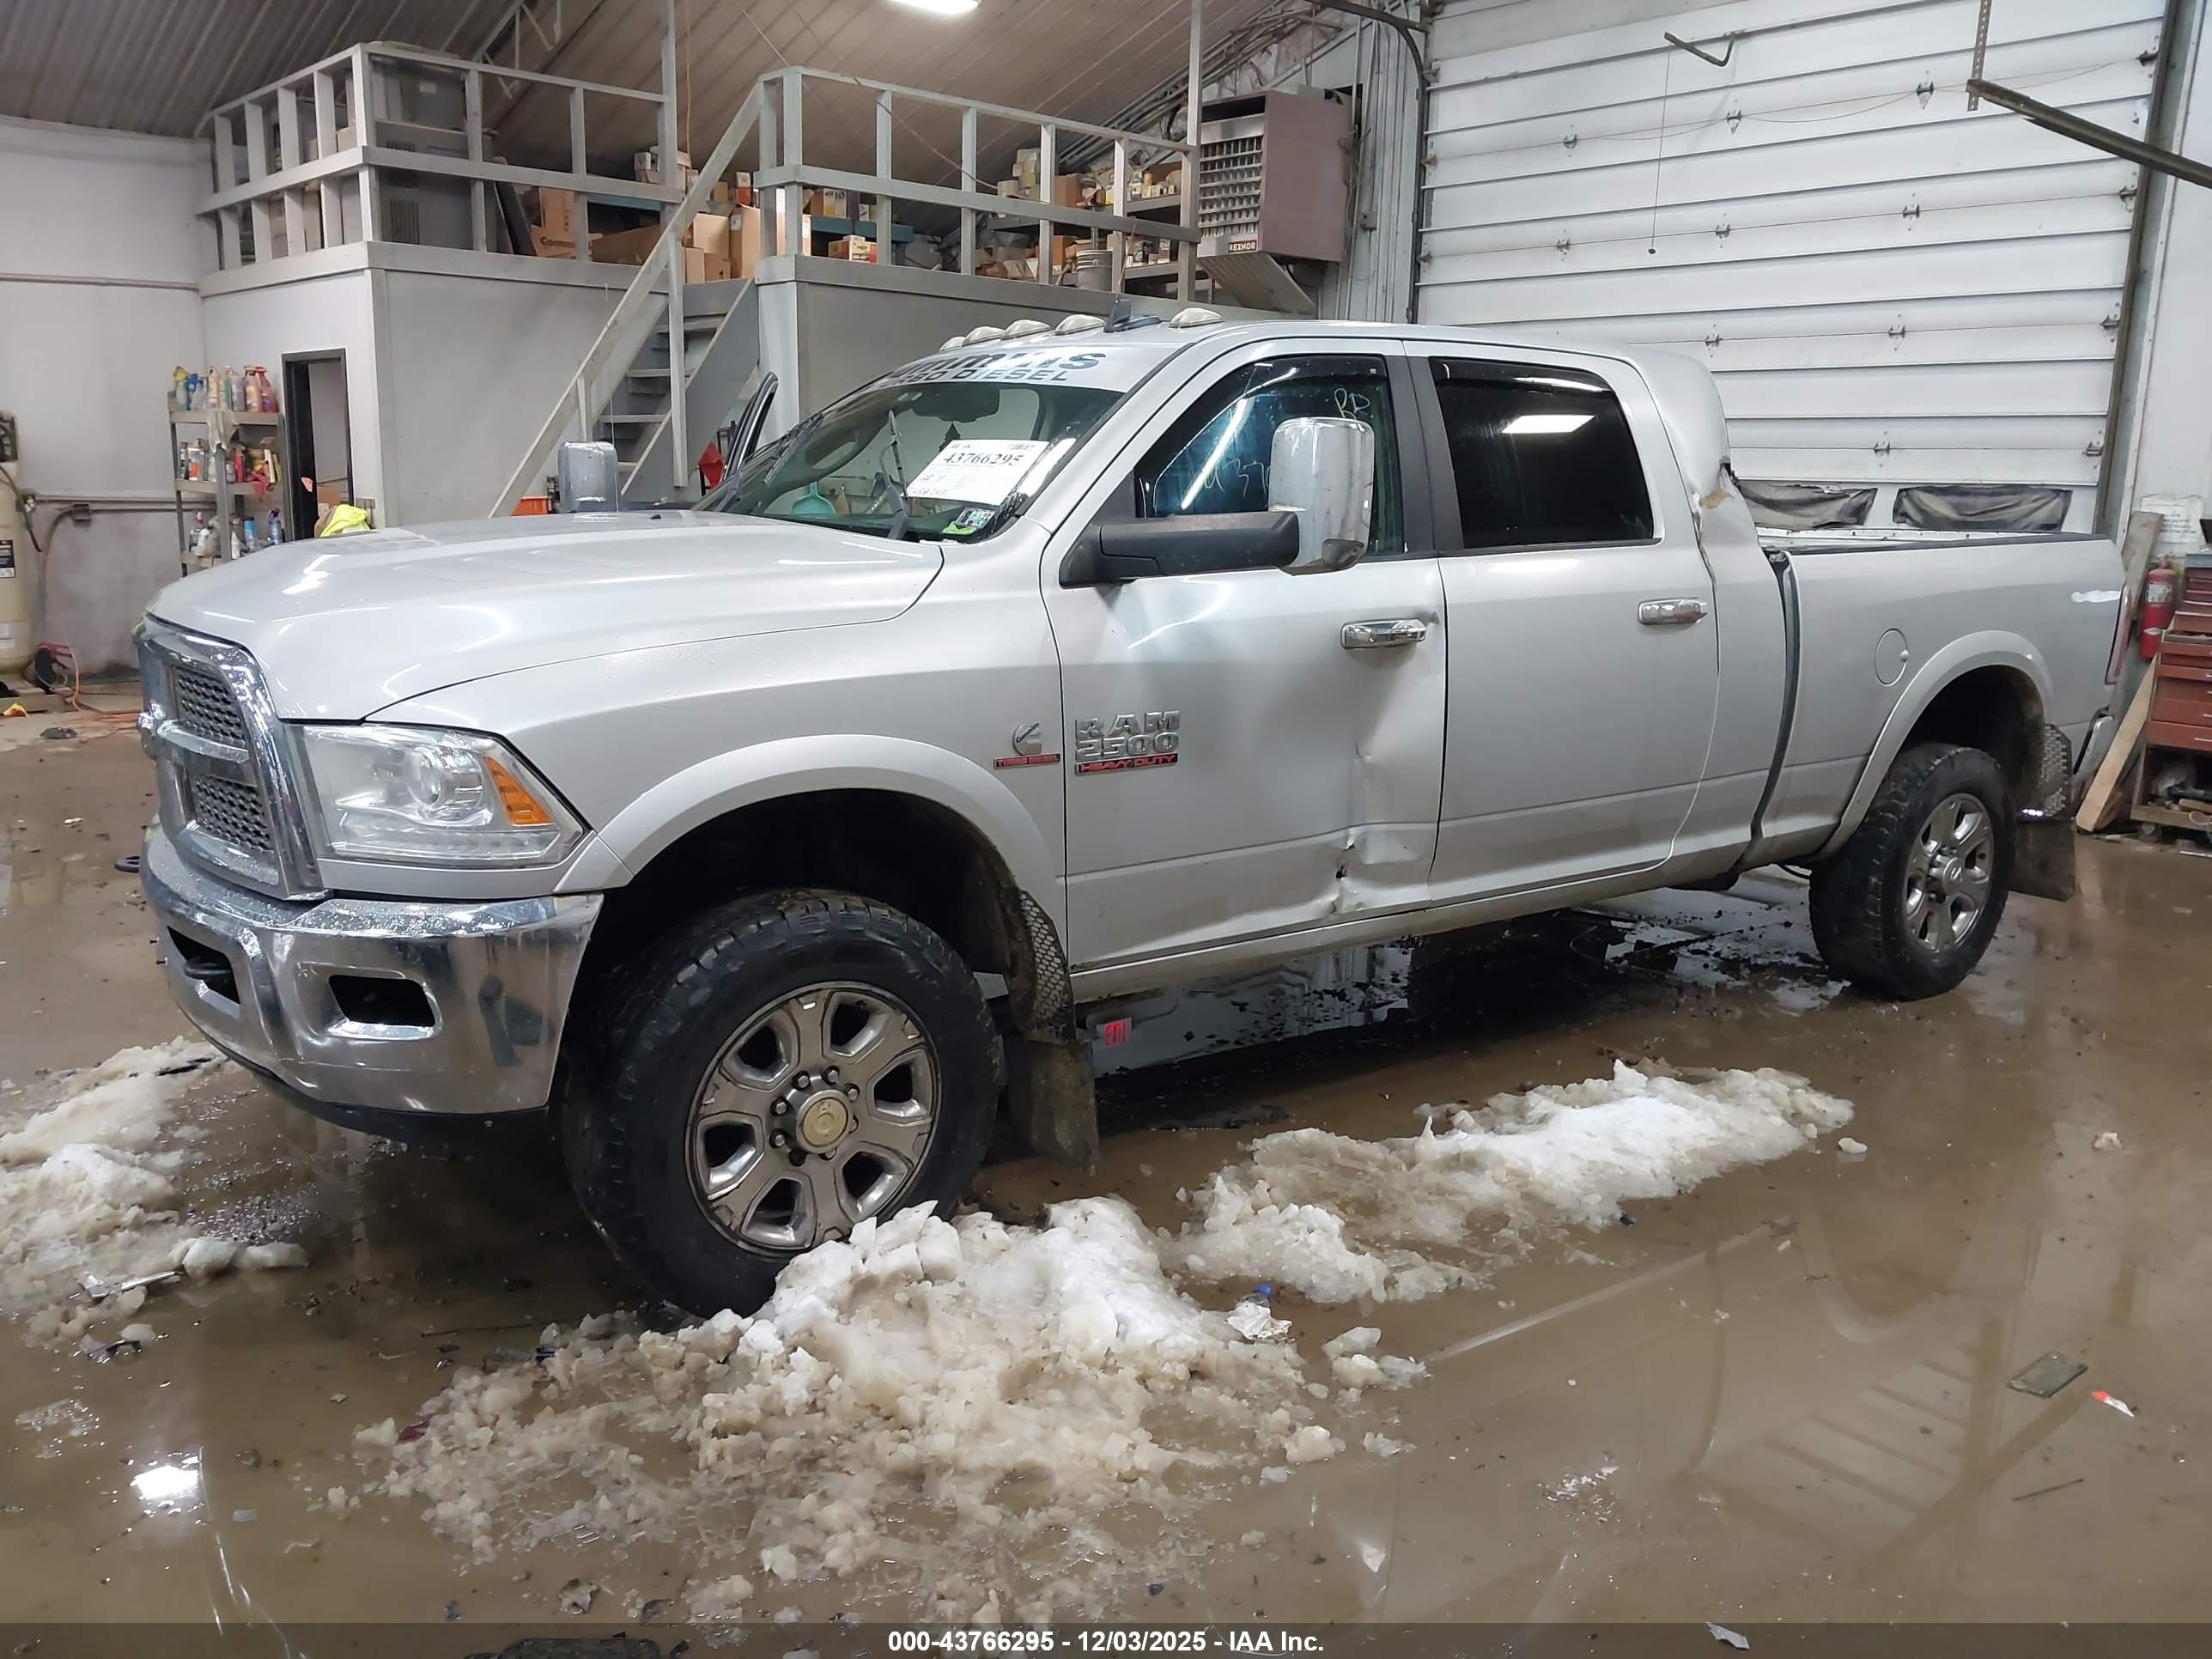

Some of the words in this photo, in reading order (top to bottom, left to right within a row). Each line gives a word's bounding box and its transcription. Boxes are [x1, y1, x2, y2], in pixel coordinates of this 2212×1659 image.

[1229, 242, 1256, 252] REZNOR
[951, 369, 1068, 382] DIESEL
[943, 453, 1024, 466] 43766295
[1075, 710, 1181, 737] RAM
[1075, 732, 1180, 761] 2500
[1080, 759, 1128, 772] HEAVY
[1133, 754, 1176, 766] DUTY
